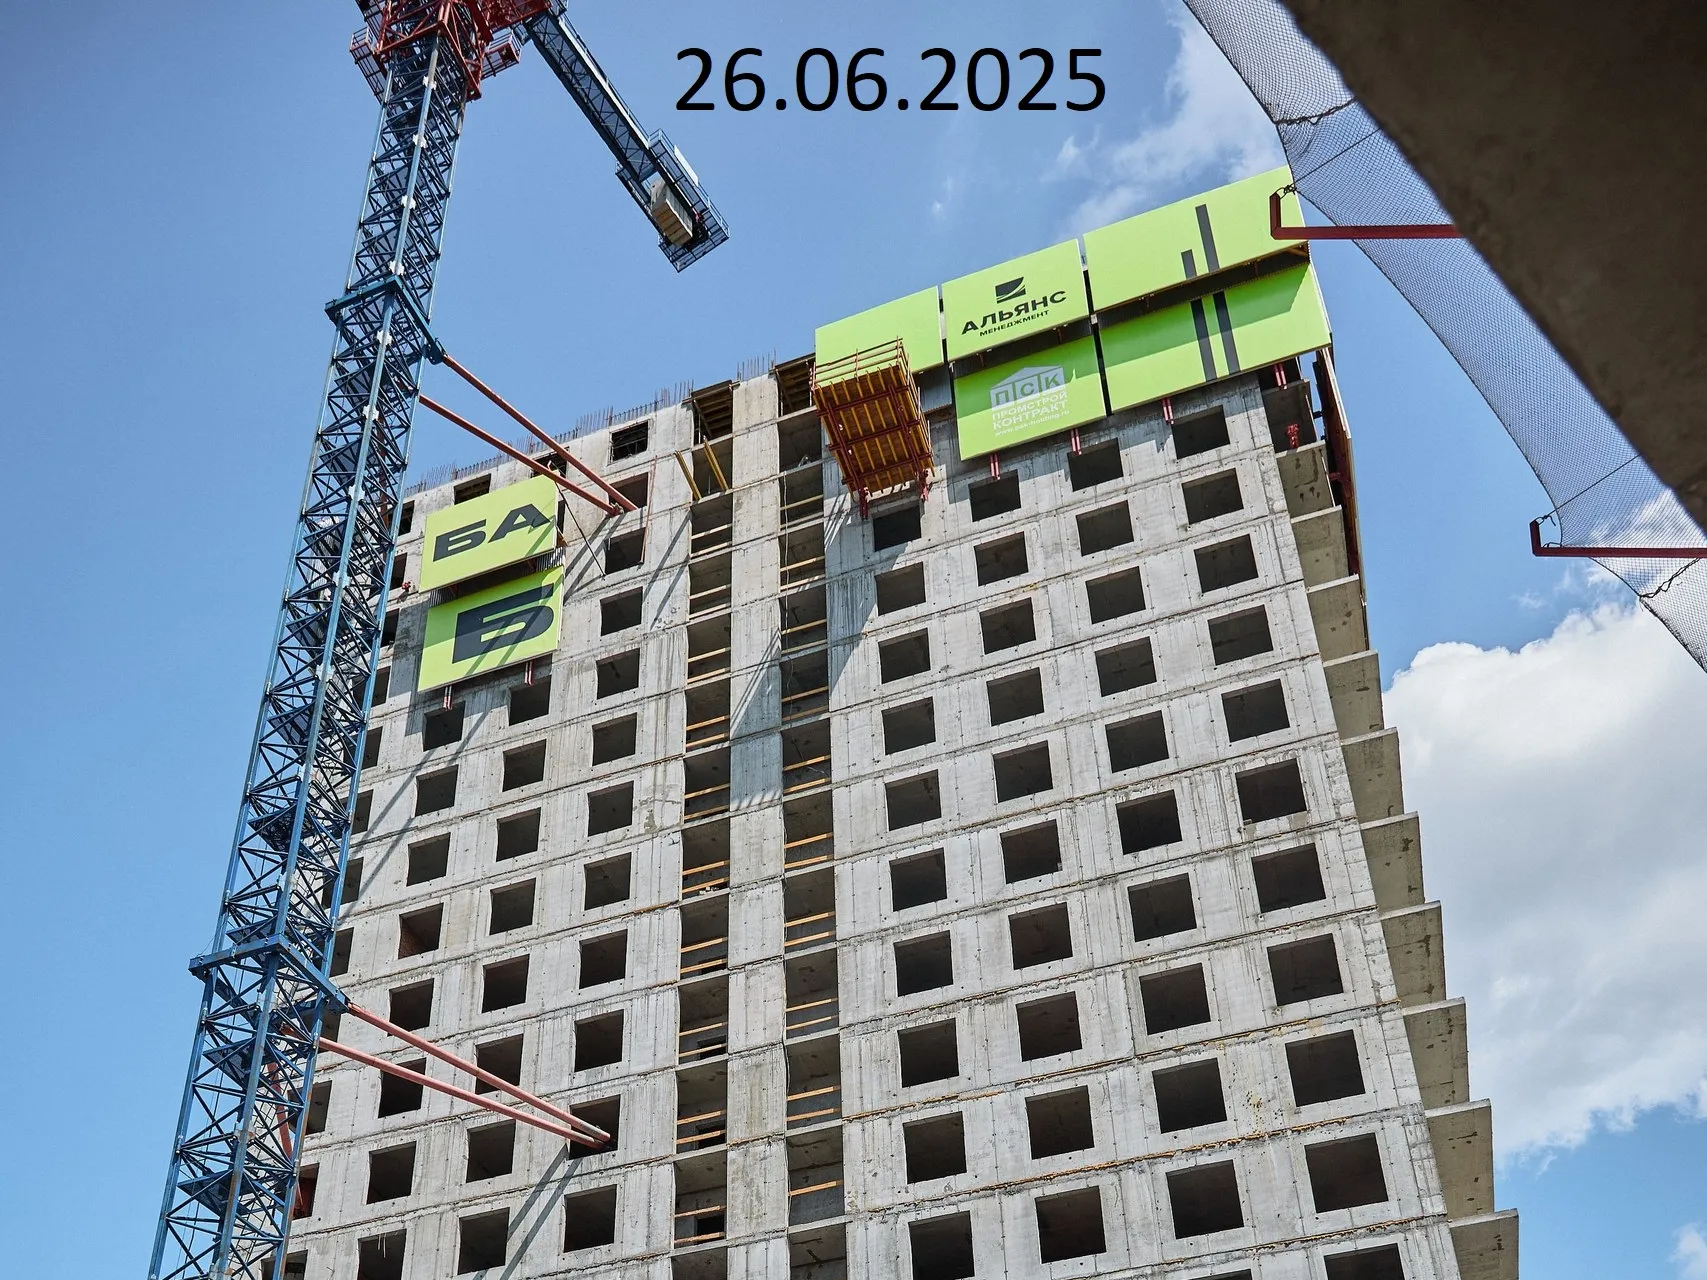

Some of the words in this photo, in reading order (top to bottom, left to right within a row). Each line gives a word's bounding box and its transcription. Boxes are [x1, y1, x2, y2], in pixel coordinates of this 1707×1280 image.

[962, 290, 1067, 335] АЛЬЯНС
[979, 310, 1050, 337] МЕНЕДЖМЕНТ
[992, 391, 1068, 421] ПРОМСТРОЙ
[994, 375, 1060, 406] ПСК
[993, 400, 1068, 430] КОНТРАКТ
[433, 503, 551, 562] БА
[452, 583, 555, 664] Б
